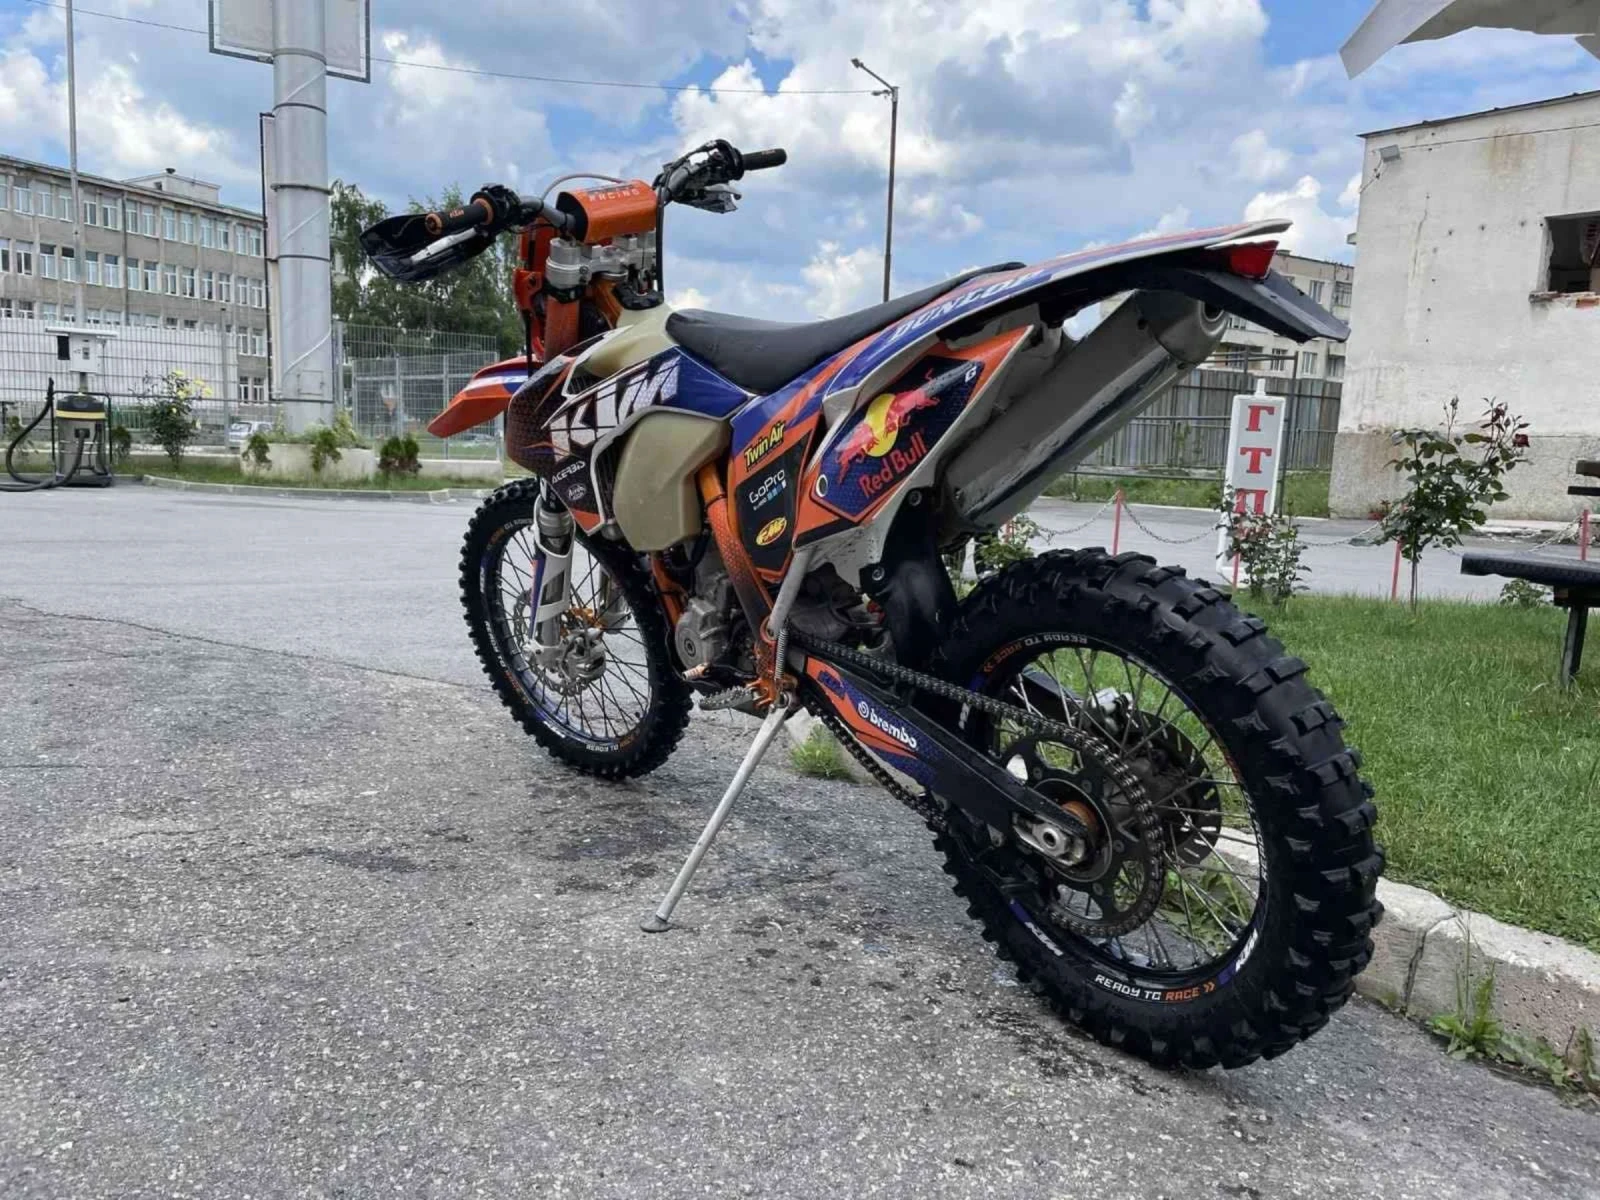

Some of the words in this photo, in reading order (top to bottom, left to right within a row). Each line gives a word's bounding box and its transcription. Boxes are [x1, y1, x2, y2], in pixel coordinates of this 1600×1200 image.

[744, 437, 769, 467] Twin
[769, 422, 785, 448] Air
[859, 457, 894, 498] Red
[890, 431, 928, 474] Bull
[748, 469, 785, 504] GoPro
[869, 708, 918, 749] brembo
[1095, 974, 1141, 998] READY
[1144, 988, 1162, 1001] TO
[1164, 986, 1201, 1001] RACE
